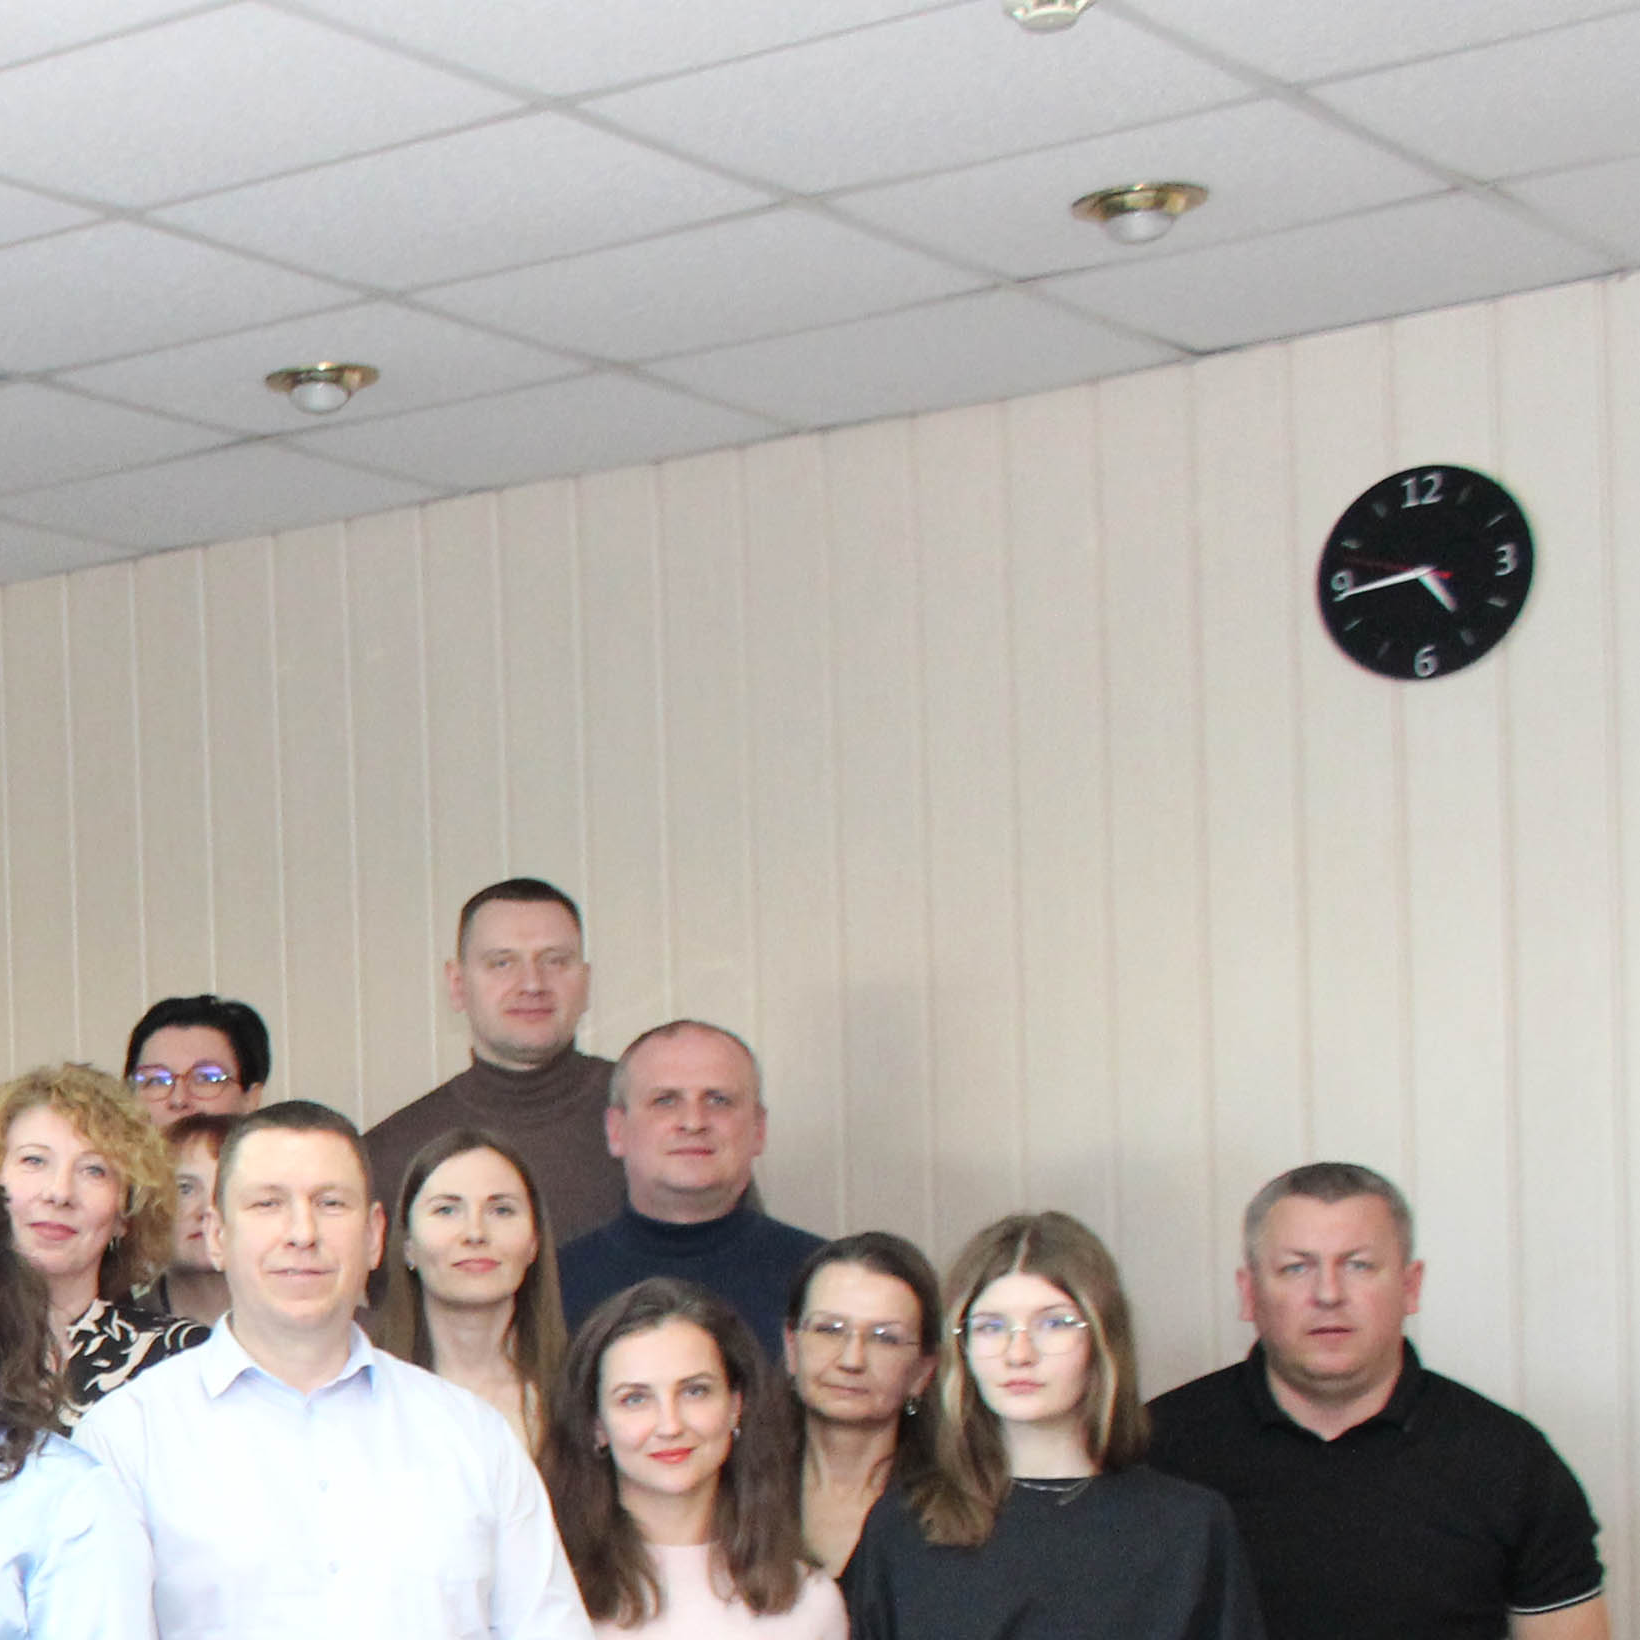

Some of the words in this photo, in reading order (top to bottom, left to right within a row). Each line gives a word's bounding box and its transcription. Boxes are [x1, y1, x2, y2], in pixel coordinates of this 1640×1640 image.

[1400, 472, 1445, 509] 12
[1494, 542, 1518, 577] 3
[1329, 570, 1354, 602] 9
[1414, 645, 1439, 678] 6
